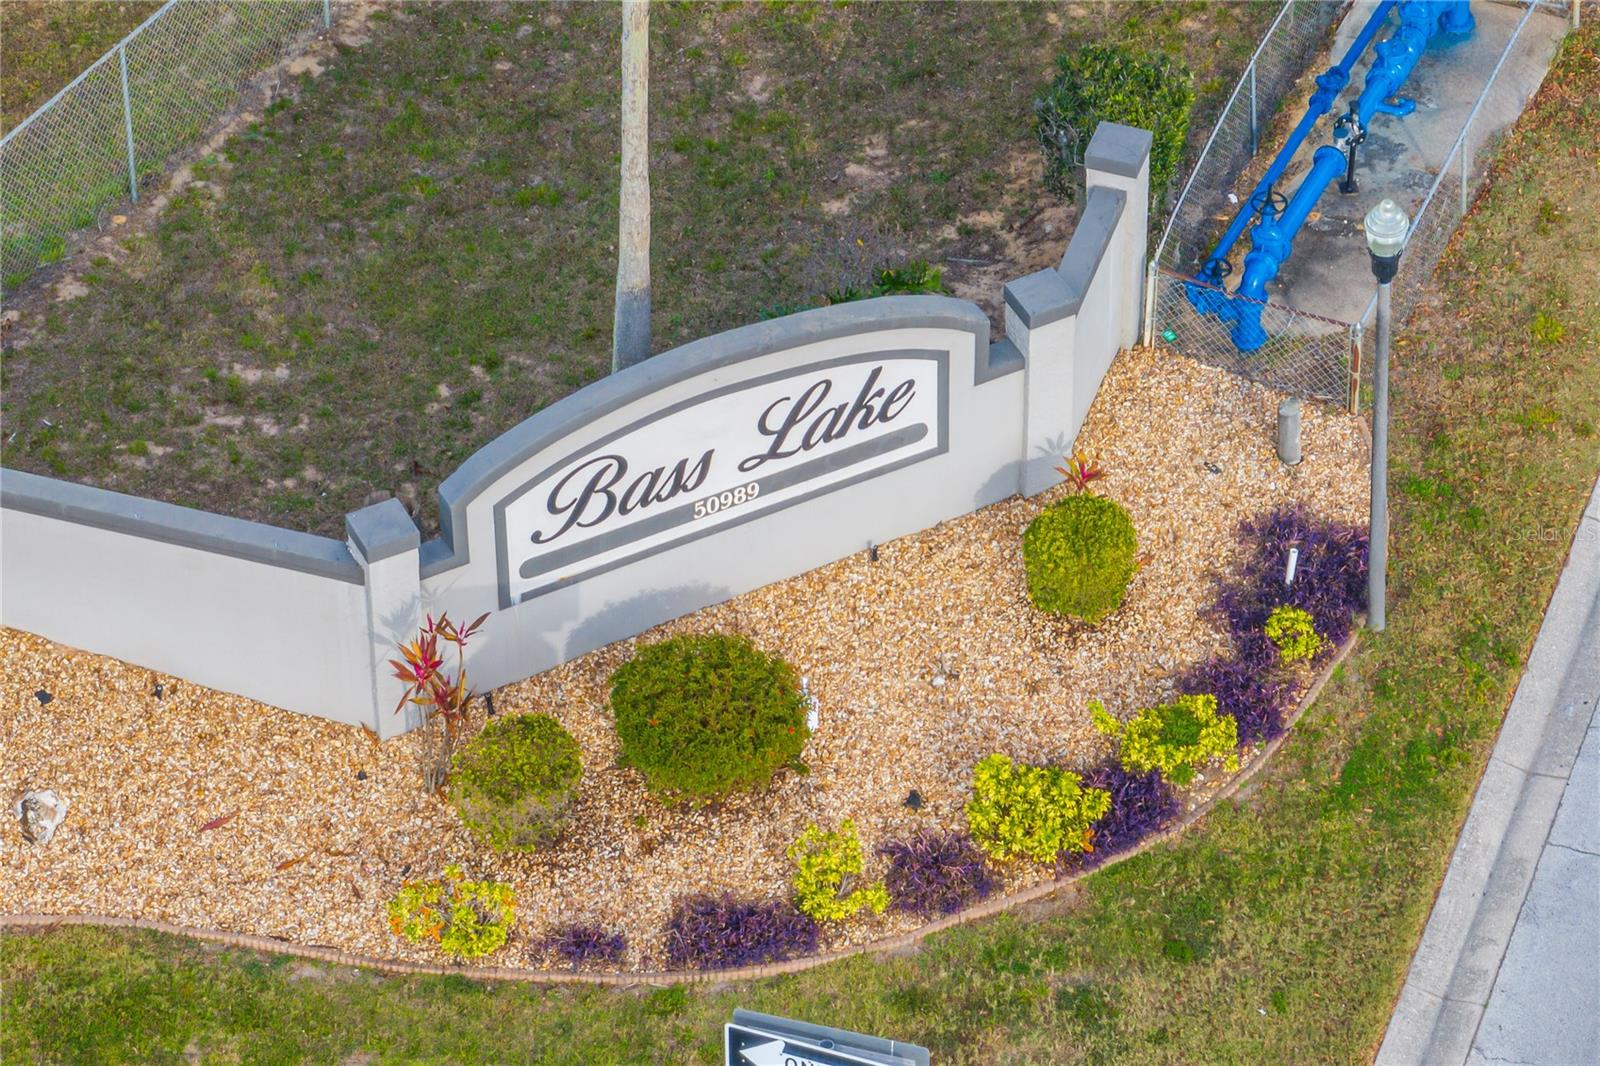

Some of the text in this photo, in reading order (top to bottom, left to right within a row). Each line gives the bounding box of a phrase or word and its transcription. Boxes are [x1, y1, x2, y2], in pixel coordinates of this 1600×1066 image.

[531, 365, 917, 545] Bass Lake
[693, 482, 760, 520] 50989
